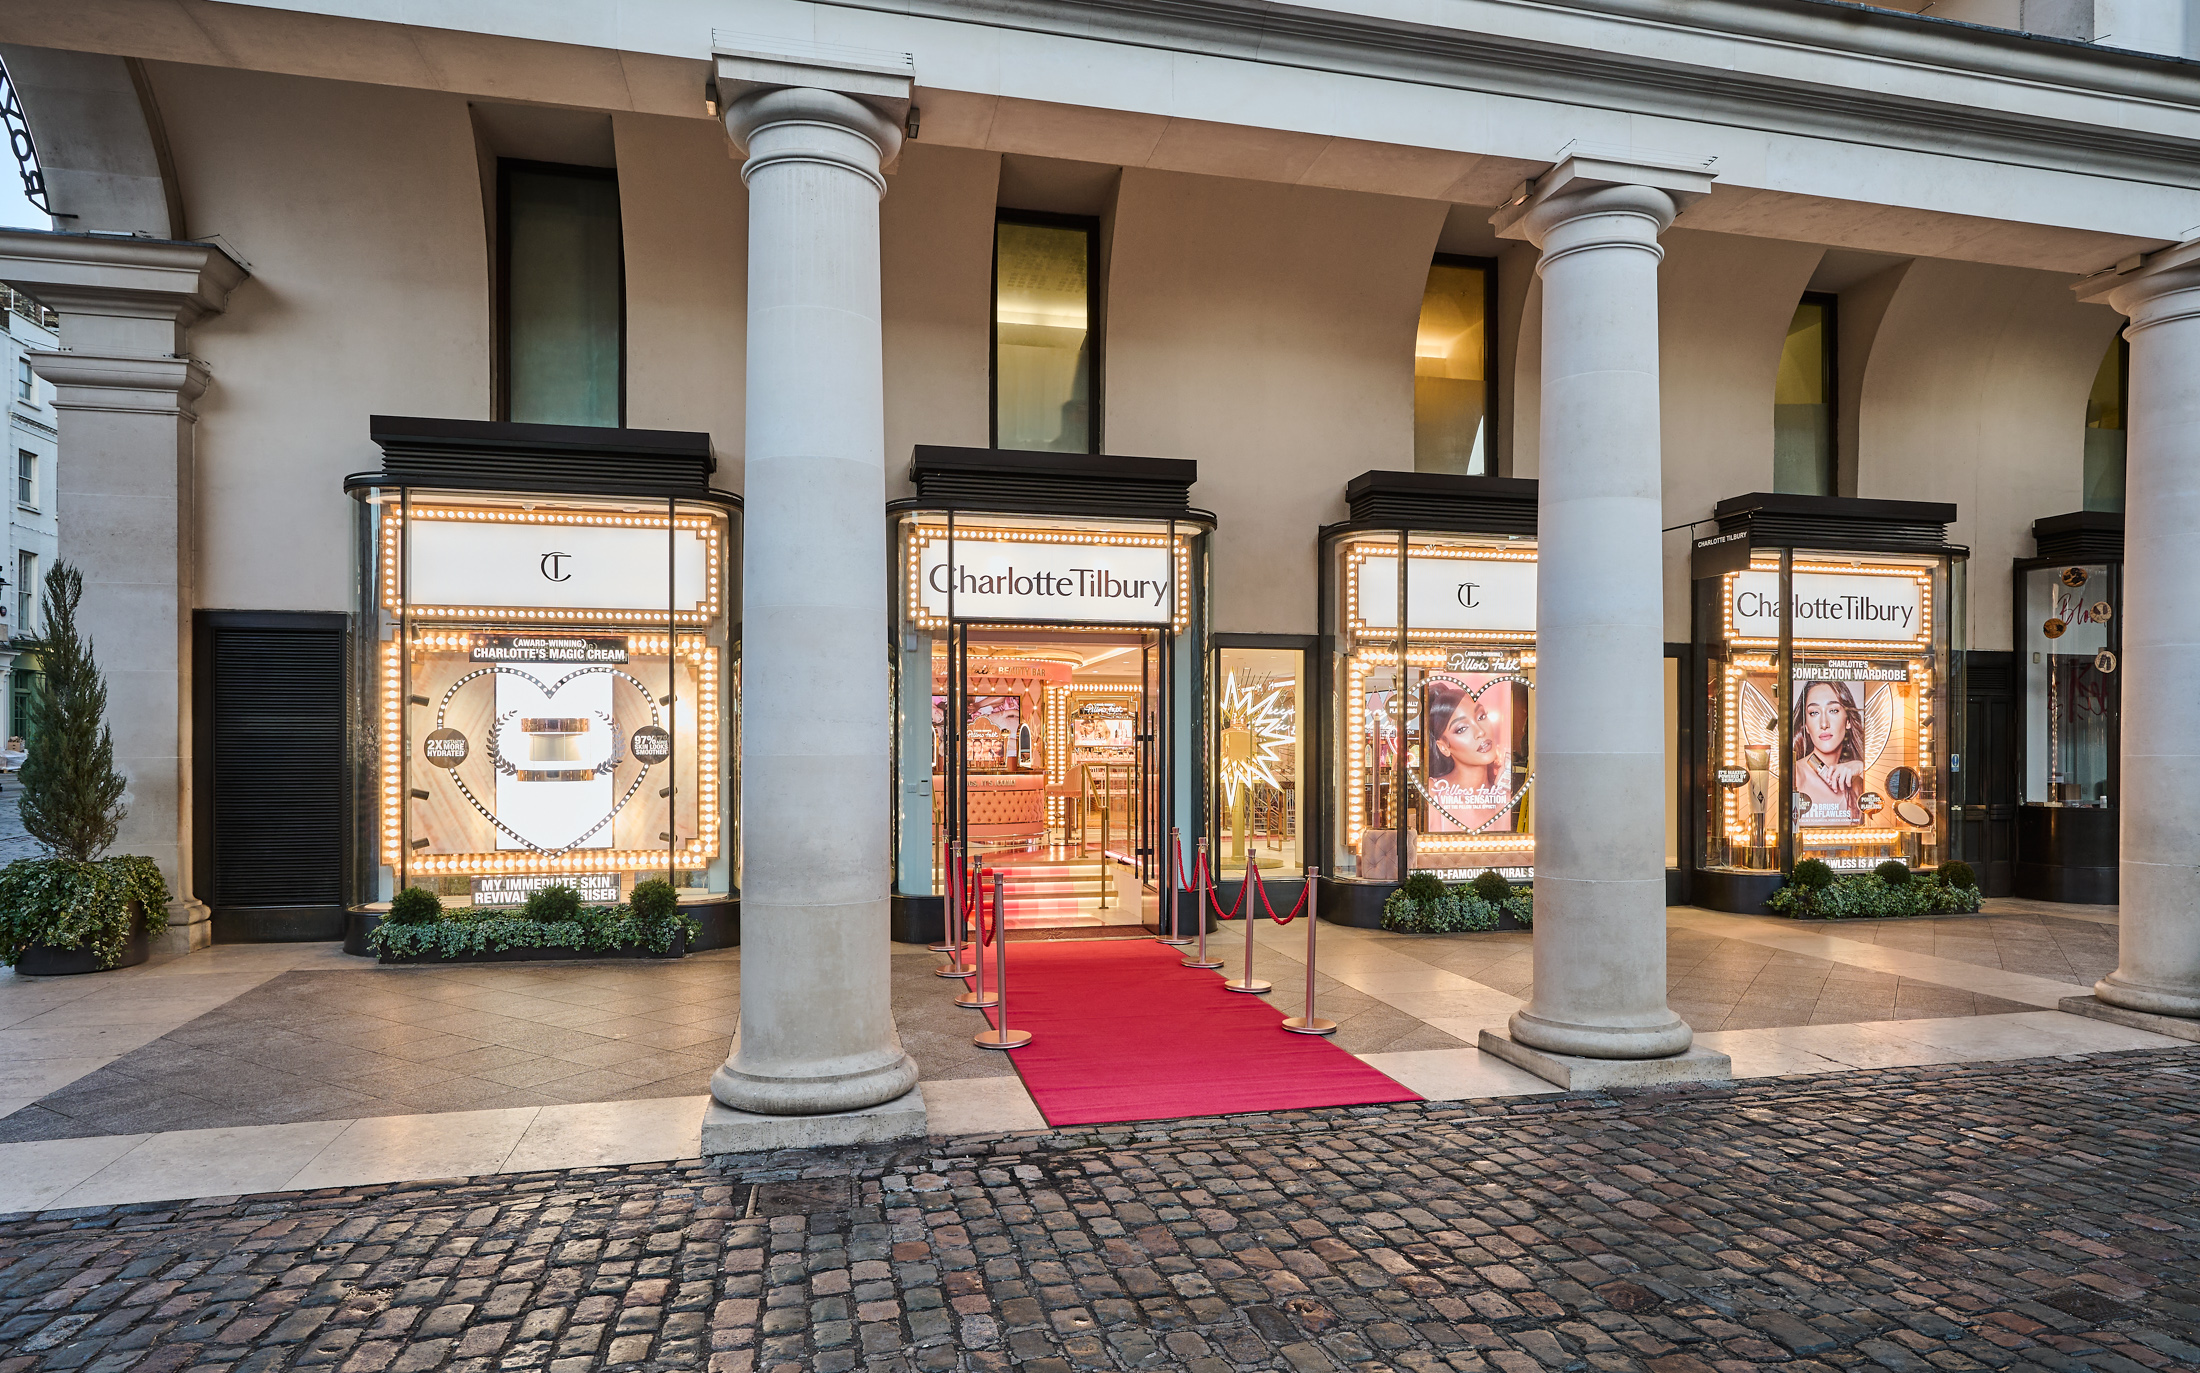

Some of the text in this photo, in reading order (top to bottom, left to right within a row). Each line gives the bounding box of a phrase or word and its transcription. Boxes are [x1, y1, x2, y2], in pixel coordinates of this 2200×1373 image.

[1697, 531, 1748, 548] CHARLOTTE TILBURY
[512, 637, 587, 649] (AWARD-WINNING)
[473, 647, 625, 660] CHARLOTTE'S MAGIC CREAM
[1447, 653, 1521, 671] Pillow talk
[1828, 660, 1869, 668] CHARLOTTE'S
[1031, 667, 1046, 677] BAR
[1853, 669, 1907, 681] WARDROBE
[427, 740, 443, 750] 2X
[1431, 779, 1506, 796] Pillow talk
[1441, 795, 1463, 804] VIRAL
[1465, 794, 1506, 804] SENSATION
[1818, 803, 1839, 811] BRUSH
[1818, 810, 1851, 818] FLAWLESS
[1858, 859, 1866, 869] IS
[1867, 859, 1874, 868] A
[1501, 867, 1525, 878] VIRAL
[481, 879, 501, 891] MY
[580, 877, 610, 888] SKIN
[475, 891, 529, 904] REVIVAL
